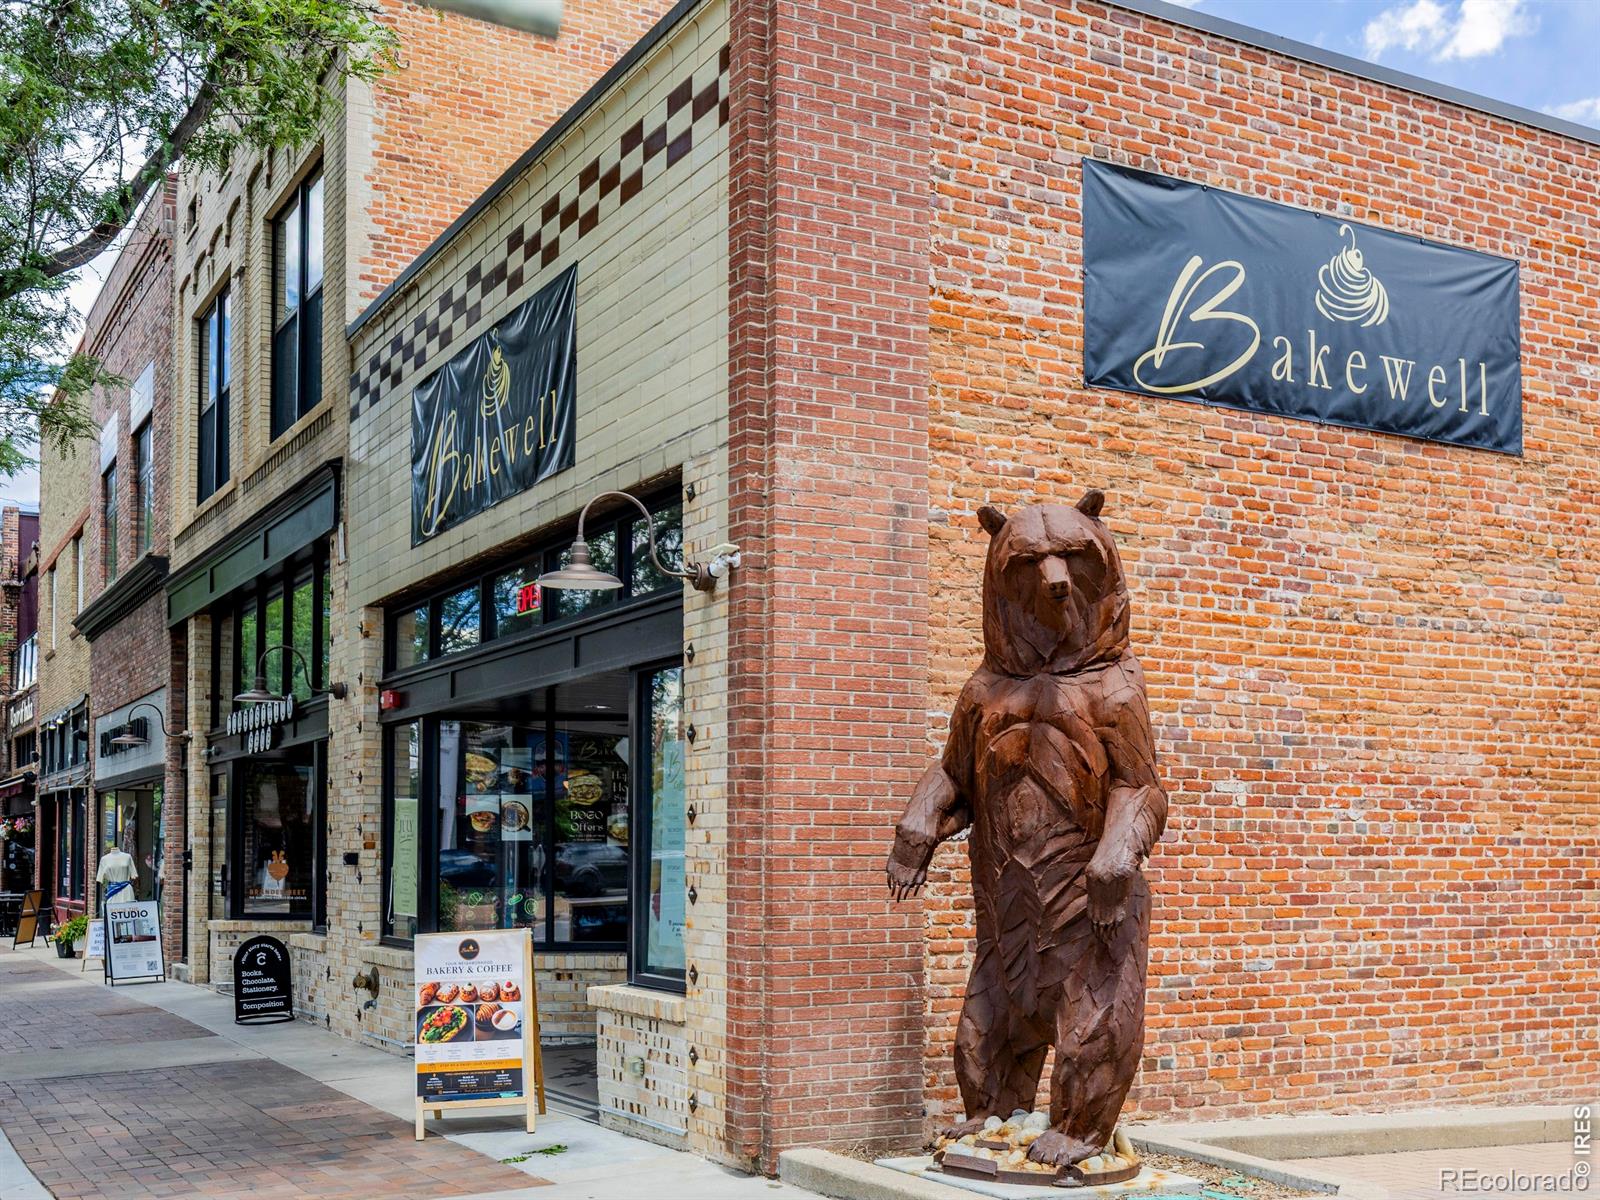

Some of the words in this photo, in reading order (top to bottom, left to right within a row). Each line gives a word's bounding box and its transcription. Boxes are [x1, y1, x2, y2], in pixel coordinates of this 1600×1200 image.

[1133, 255, 1490, 416] Bakewell
[421, 389, 557, 537] Bakewell
[110, 909, 149, 920] STUDIO
[426, 966, 465, 975] BAKERY
[466, 966, 474, 974] &
[476, 964, 513, 973] COFFEE
[241, 977, 276, 986] Chocolate.
[242, 985, 279, 994] Stationery.
